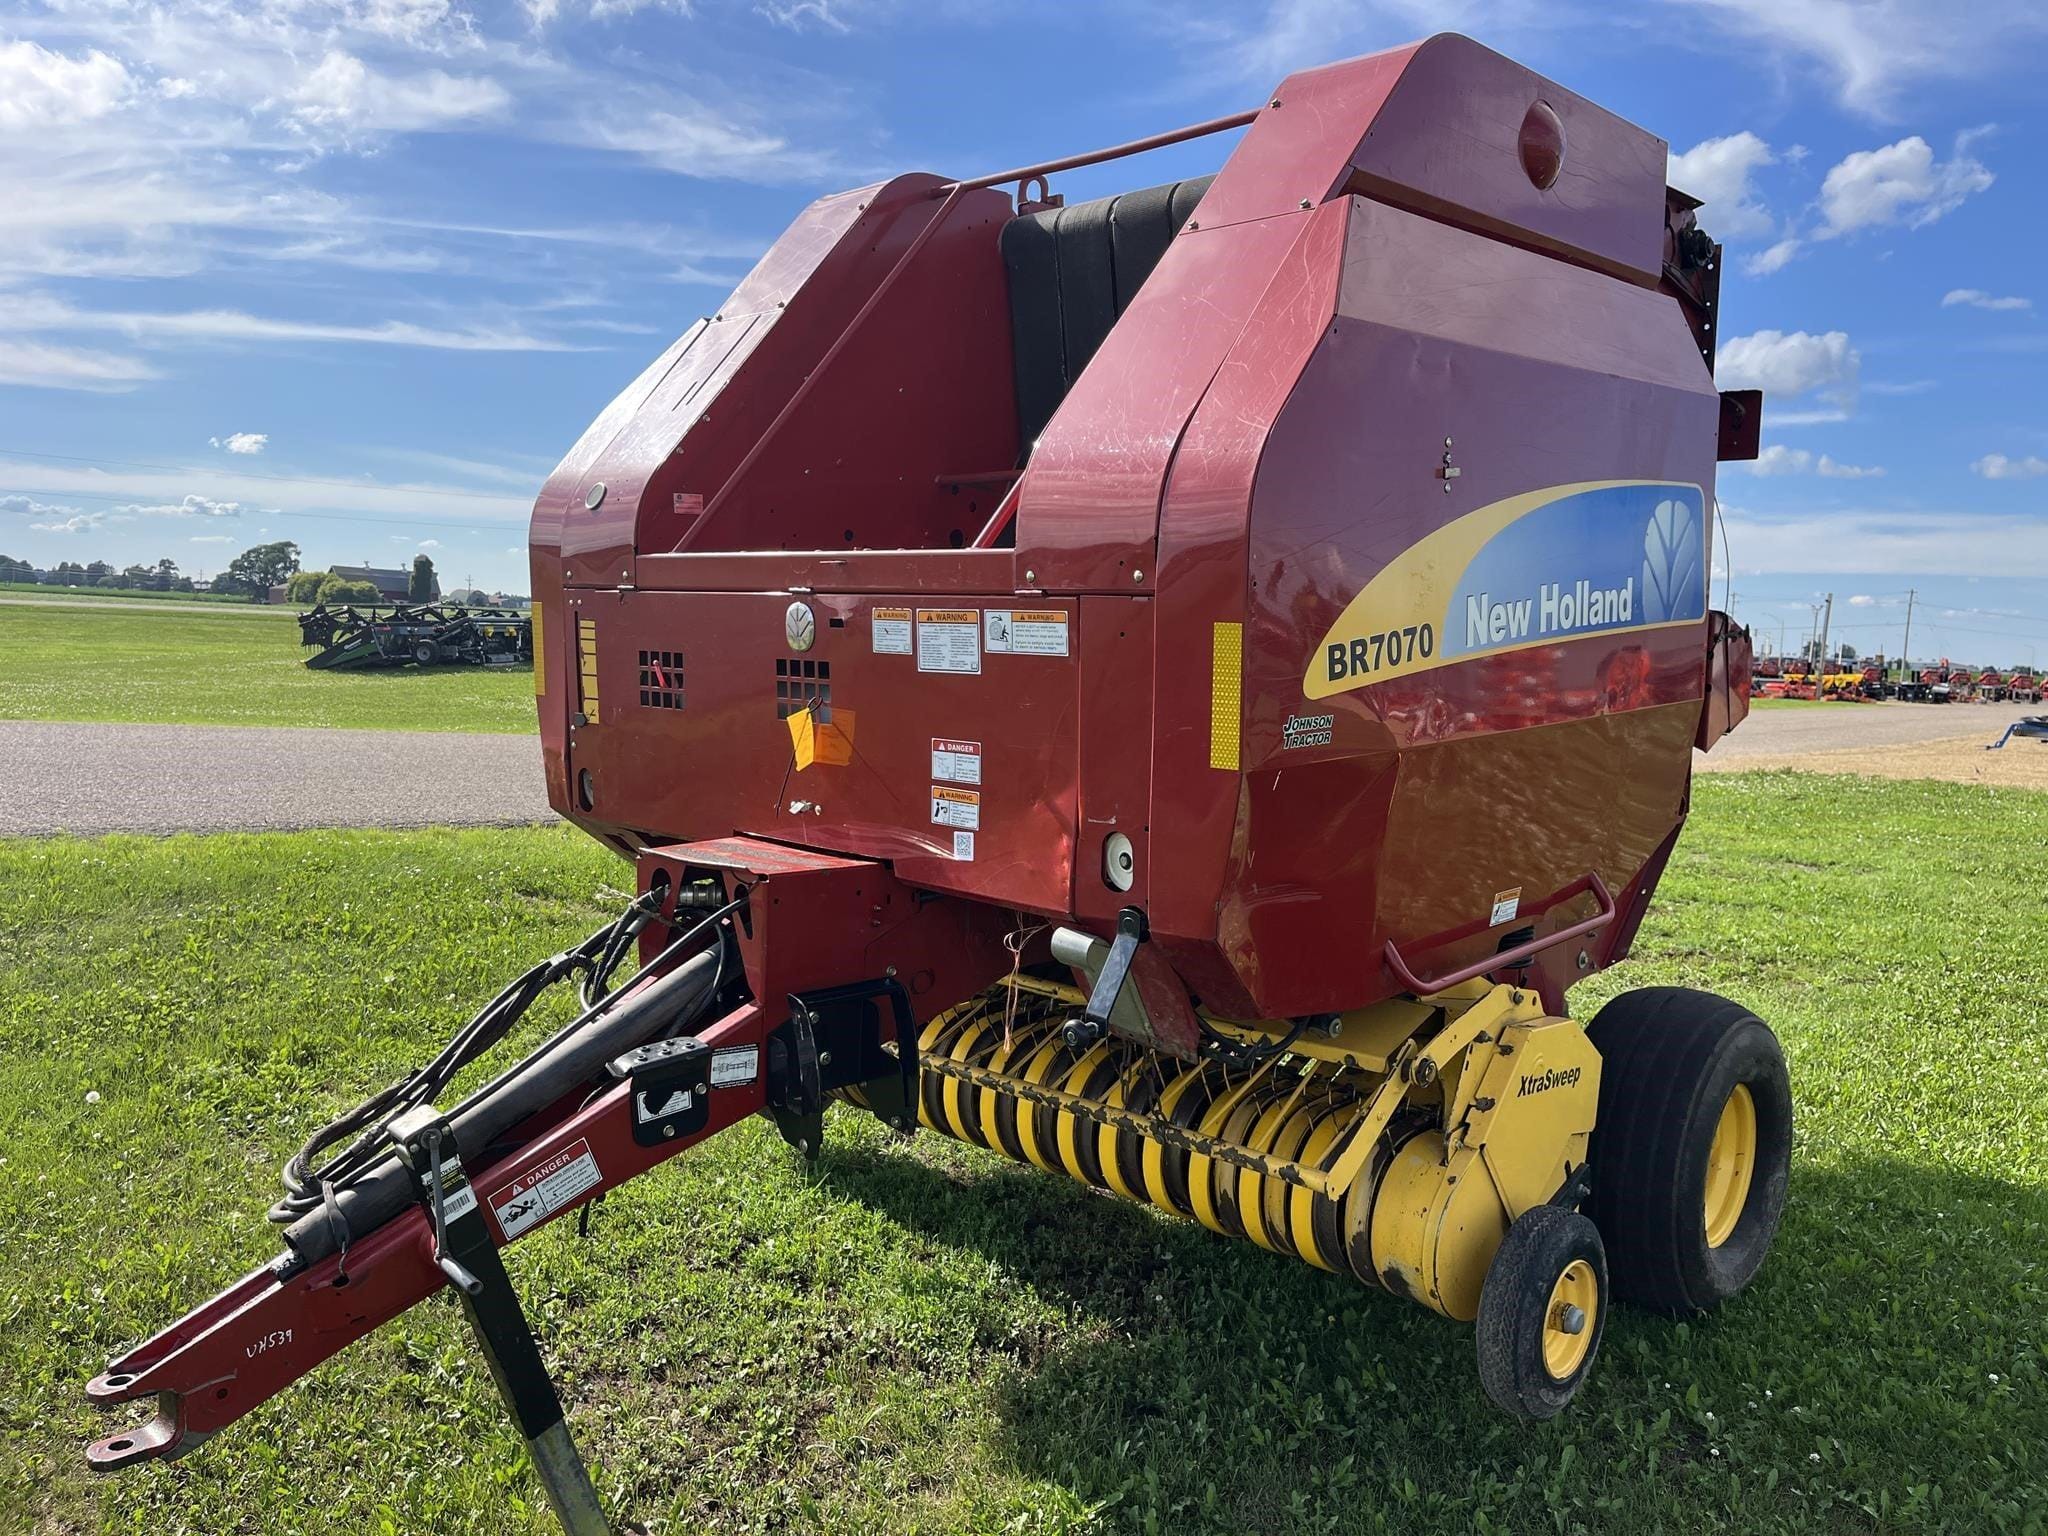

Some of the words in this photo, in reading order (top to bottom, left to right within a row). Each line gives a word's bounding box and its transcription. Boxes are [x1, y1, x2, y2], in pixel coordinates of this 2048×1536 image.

[935, 613, 968, 622] WARNING
[1465, 592, 1533, 649] New
[1539, 576, 1634, 634] Holland
[1327, 623, 1434, 682] BR7070
[1283, 715, 1334, 733] JOHNSON
[947, 743, 974, 753] DANGER
[1283, 731, 1332, 749] TRACTOR
[945, 792, 974, 802] WARNING
[1517, 1066, 1581, 1098] XtraSweep
[526, 1153, 571, 1186] DANGER
